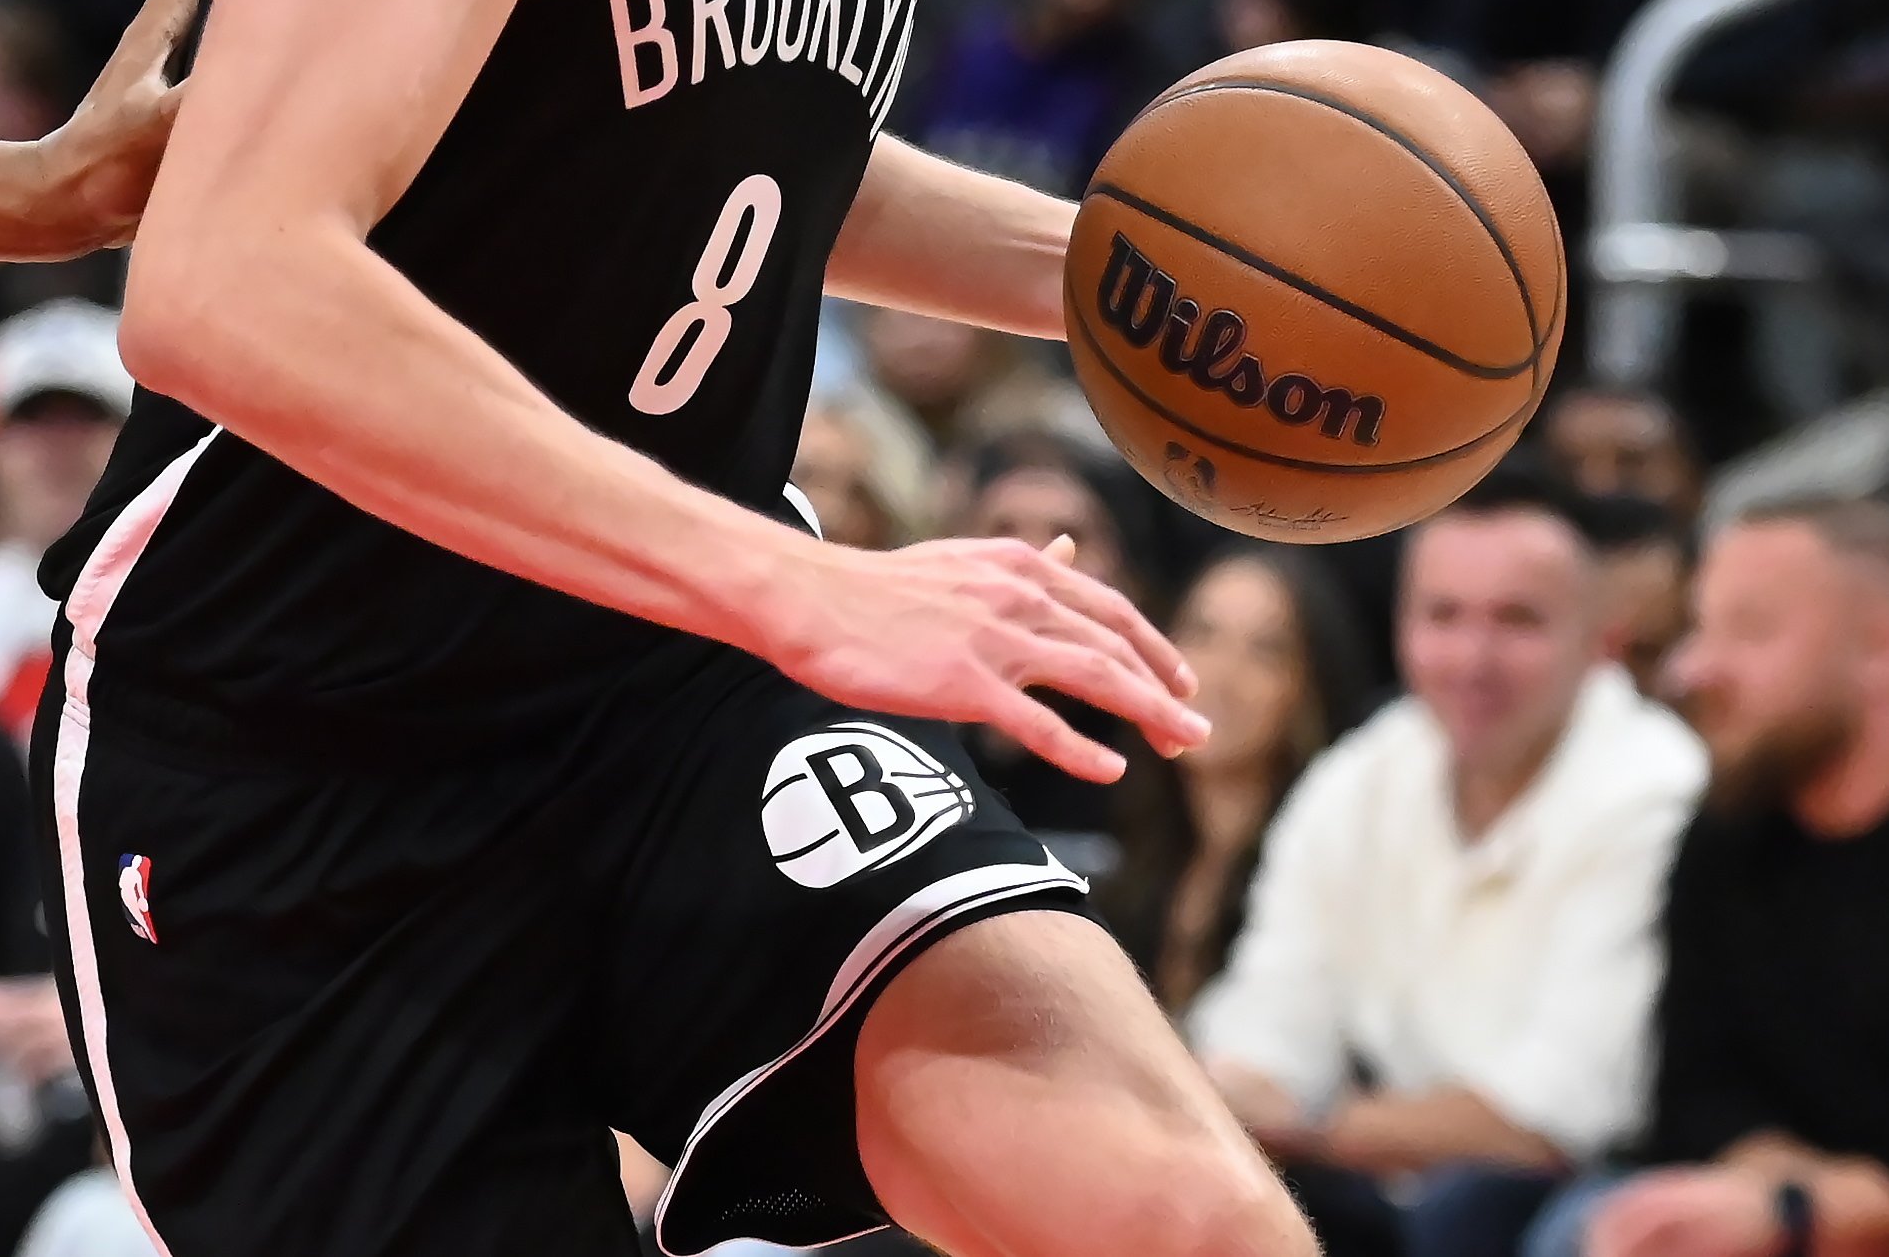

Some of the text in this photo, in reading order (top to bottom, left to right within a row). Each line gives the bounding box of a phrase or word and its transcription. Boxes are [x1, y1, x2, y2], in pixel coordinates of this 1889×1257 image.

[628, 173, 782, 415] 8
[1097, 230, 1386, 447] Wilson
[805, 743, 916, 854] B
